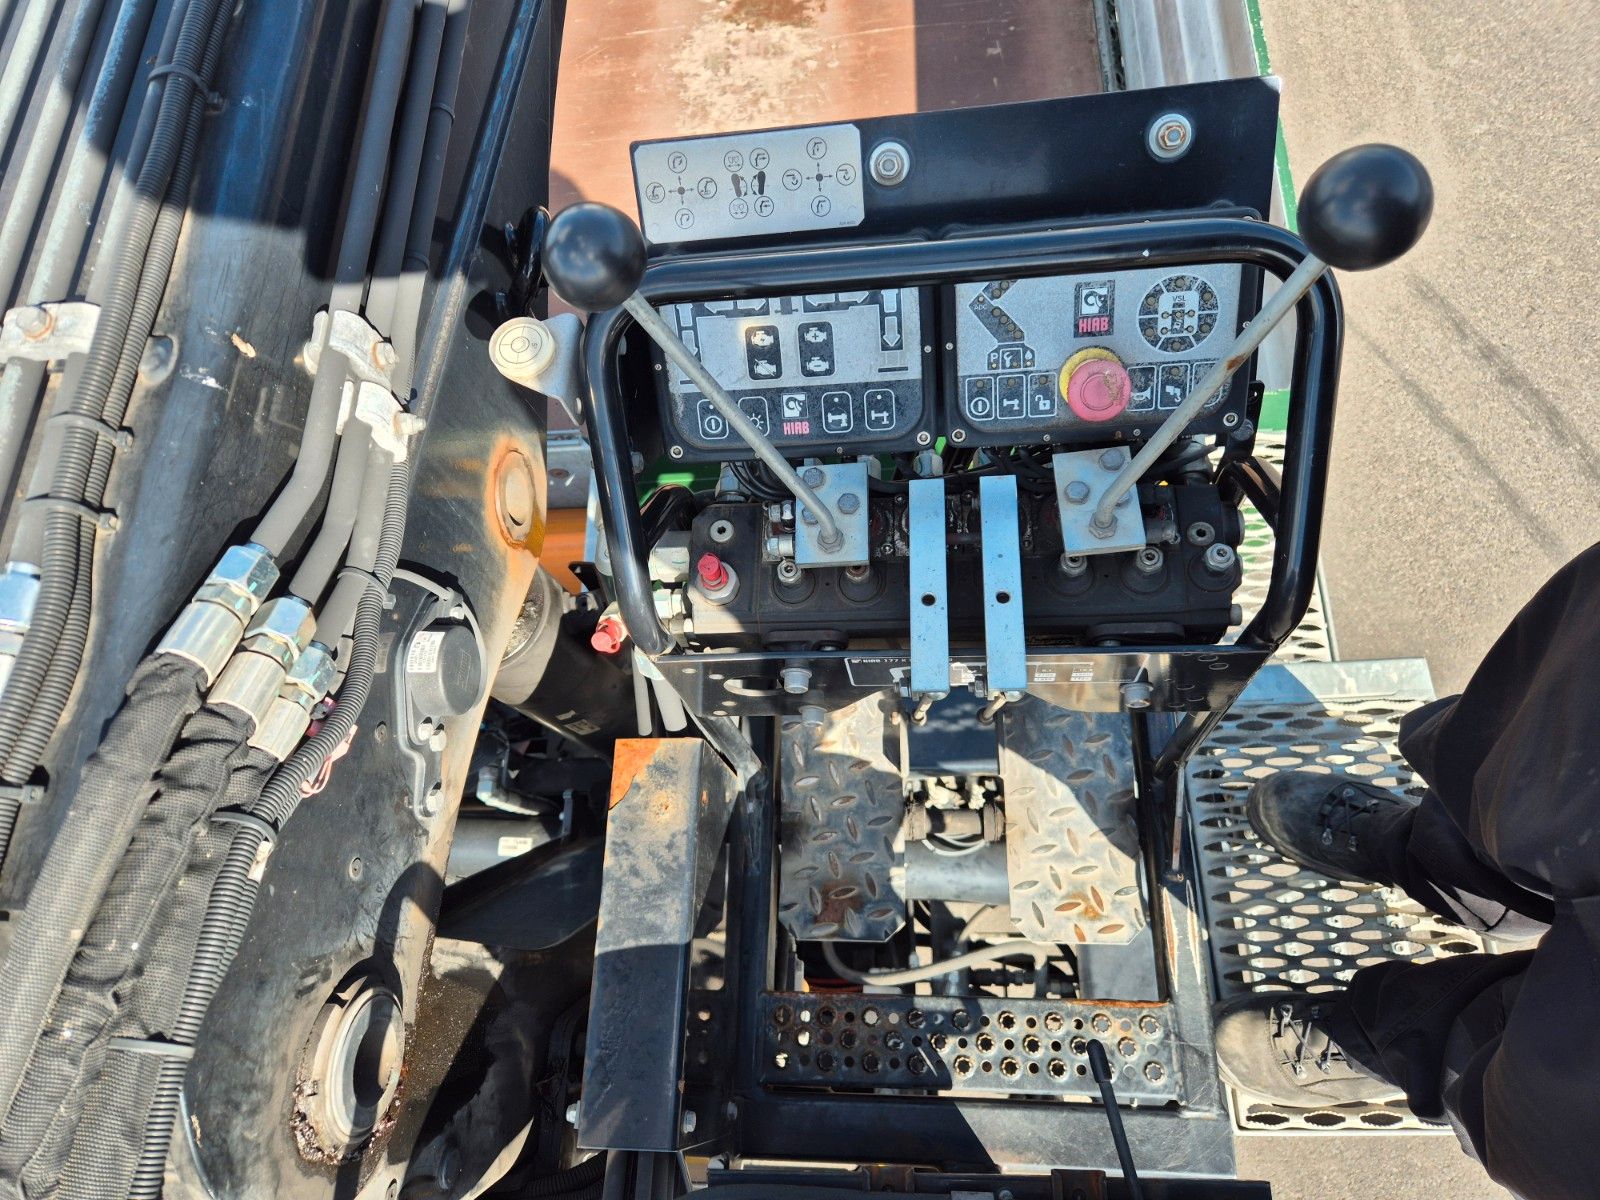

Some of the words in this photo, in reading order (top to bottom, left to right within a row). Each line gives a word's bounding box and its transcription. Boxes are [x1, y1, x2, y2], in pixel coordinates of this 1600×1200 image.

[1078, 316, 1109, 333] HIAB
[990, 352, 999, 362] P
[783, 421, 810, 435] HIAB
